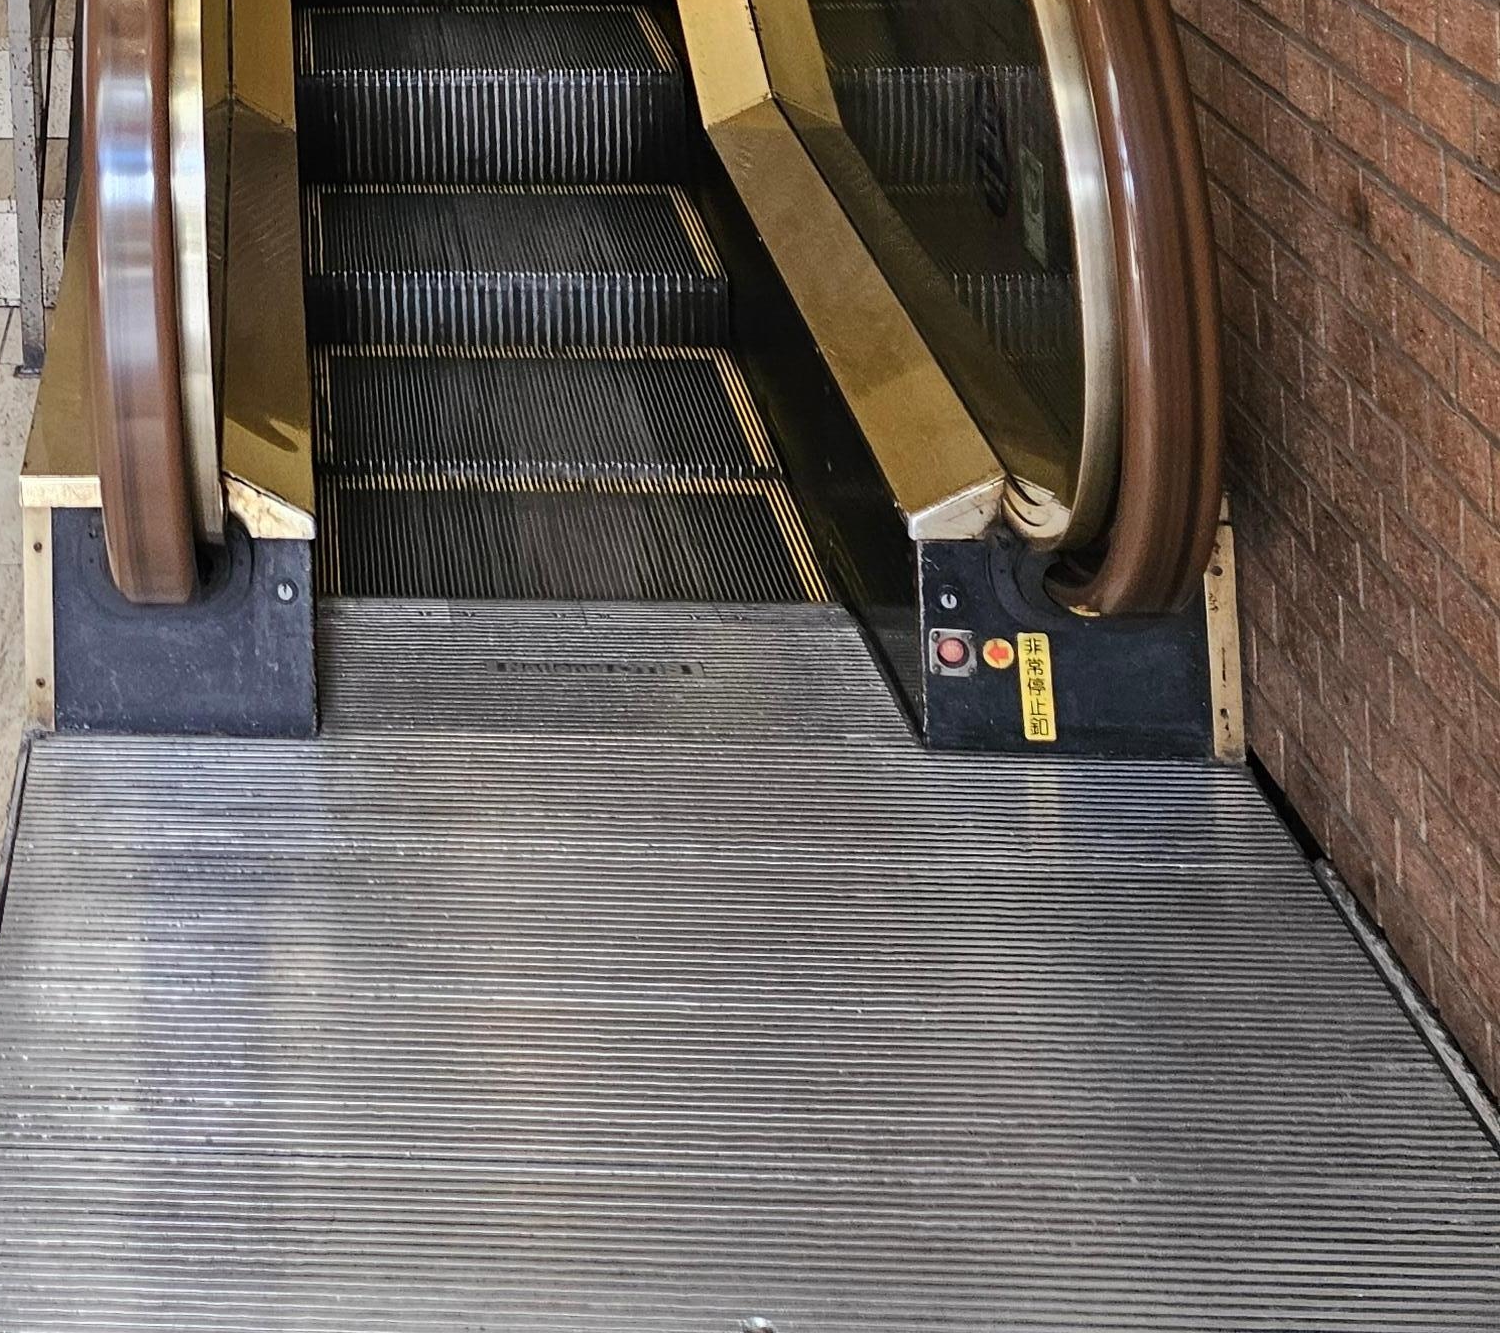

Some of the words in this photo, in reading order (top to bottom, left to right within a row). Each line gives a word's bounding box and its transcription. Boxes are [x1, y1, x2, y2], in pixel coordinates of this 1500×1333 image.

[1025, 637, 1049, 735] 非常停止釦
